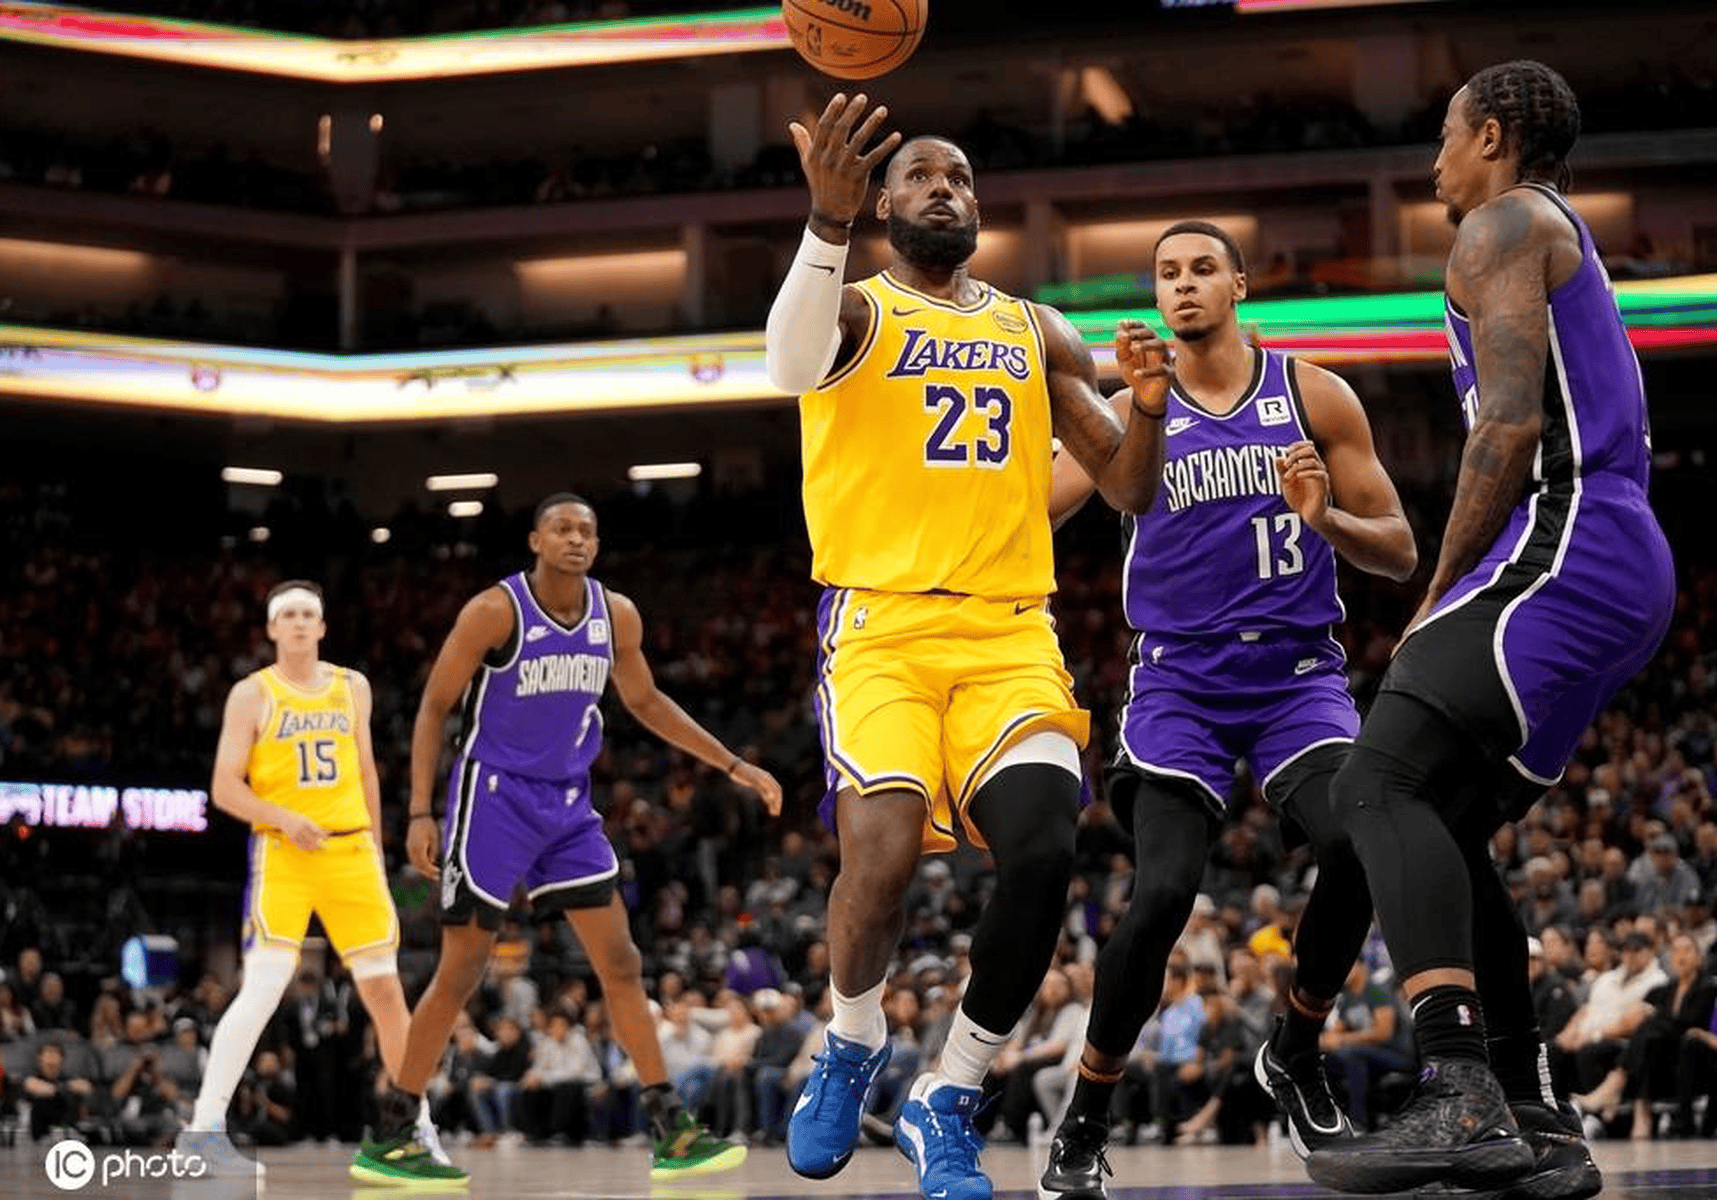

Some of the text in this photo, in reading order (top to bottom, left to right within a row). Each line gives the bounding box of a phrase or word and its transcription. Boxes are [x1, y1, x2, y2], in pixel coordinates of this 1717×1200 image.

[886, 328, 1031, 381] LAKERS
[924, 384, 1012, 466] 23
[1162, 445, 1289, 512] SACRAMEN
[1251, 512, 1304, 579] 13
[297, 739, 338, 784] 15
